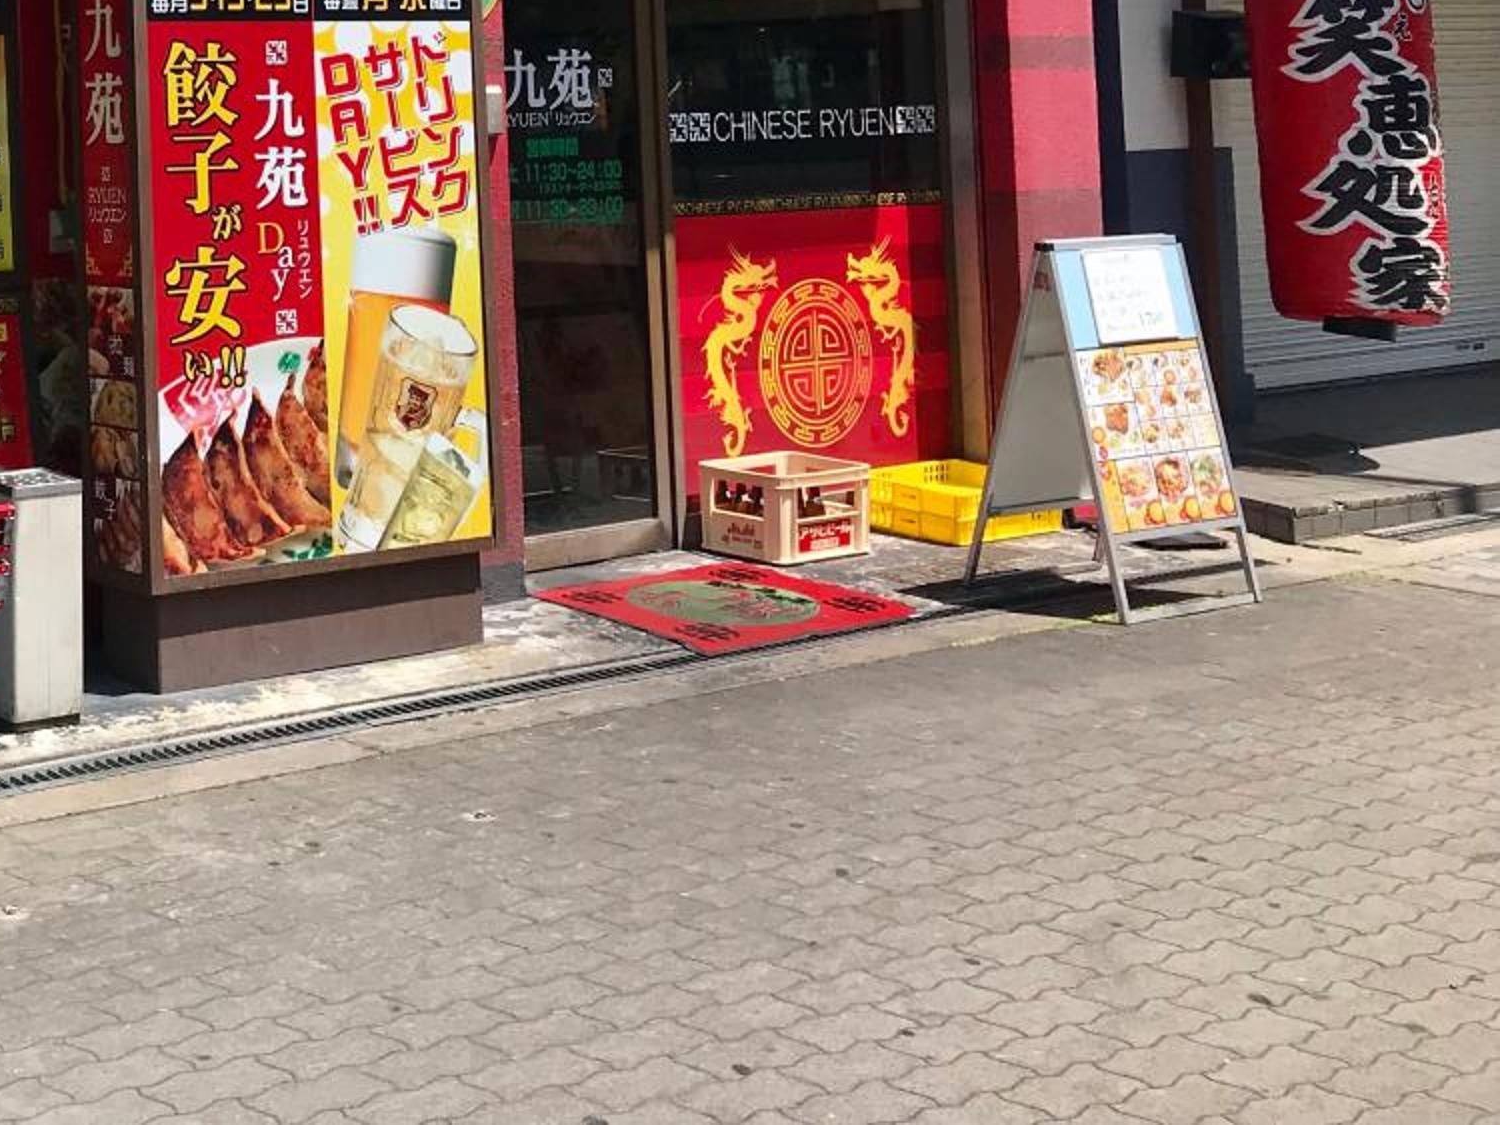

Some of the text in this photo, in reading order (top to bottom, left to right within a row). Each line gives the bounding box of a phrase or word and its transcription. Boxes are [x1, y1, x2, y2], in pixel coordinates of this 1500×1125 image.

[503, 48, 595, 111] 九苑
[253, 79, 309, 211] 九苑
[363, 41, 432, 227] サービス
[409, 31, 469, 216] ドリンク
[713, 107, 896, 142] CHINESE RYUEN
[88, 187, 127, 205] RYUEN
[256, 221, 296, 302] Day
[296, 217, 314, 300] リュウエン
